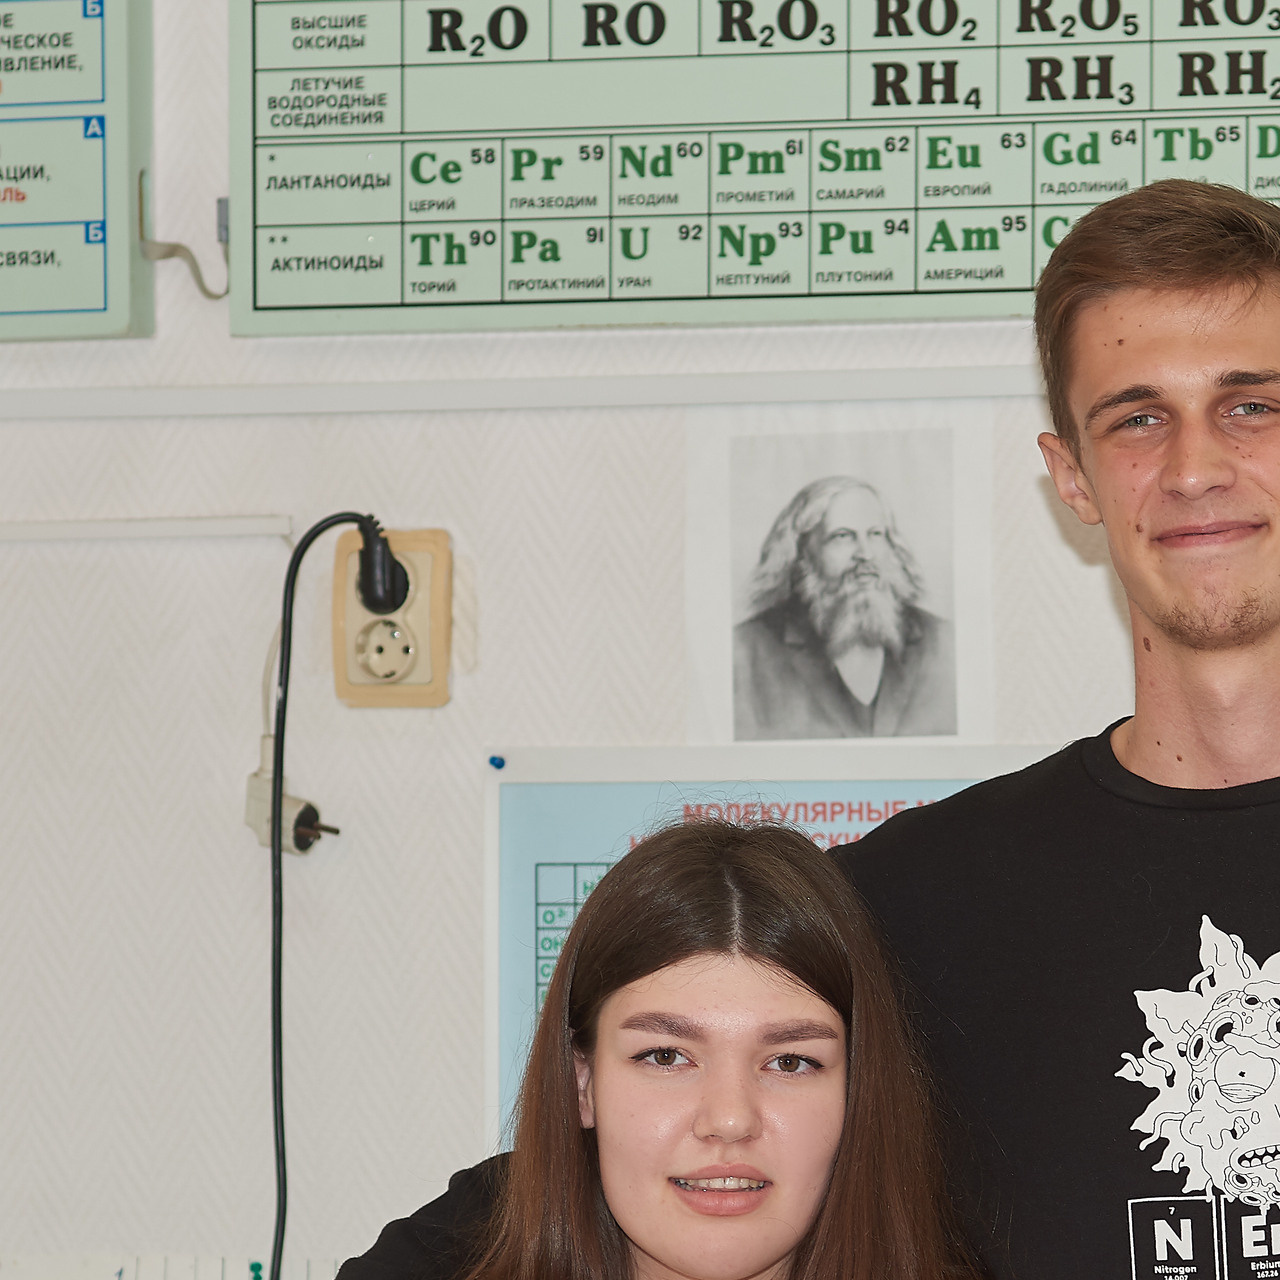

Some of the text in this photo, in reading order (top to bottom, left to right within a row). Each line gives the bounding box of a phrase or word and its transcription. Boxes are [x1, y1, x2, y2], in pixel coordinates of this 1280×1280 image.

[291, 14, 367, 31] ВЫСШИЕ
[582, 2, 666, 47] RO
[292, 35, 365, 50] ОКСИДЫ
[0, 54, 83, 72] ВЛЕНИЕ,
[291, 76, 365, 93] ЛЕТУЧИЕ
[267, 93, 387, 111] ВОДОРОДНЫЕ
[270, 111, 384, 128] СОЕДИНЕНИЯ
[926, 132, 1027, 170] Eu 63
[1042, 129, 1137, 166] Gd 64
[1154, 126, 1241, 161] Tb 65
[619, 142, 703, 179] Nd 60
[718, 139, 804, 175] Pm 61
[818, 136, 910, 172] Sm 62
[410, 148, 496, 184] Ce 58
[511, 145, 605, 182] Pr 59
[0, 164, 50, 182] ЦИИ,
[266, 173, 391, 191] ЛАНТАНОИДЫ
[923, 182, 992, 198] ЕВРОПИЙ
[1041, 178, 1128, 194] ГАДОЛИНИЙ
[617, 192, 679, 207] НЕОДИМ
[716, 189, 795, 203] ПРОМЕТИЙ
[816, 185, 885, 201] САМАРИЙ
[408, 198, 456, 213] ЦЕРИЙ
[509, 195, 597, 209] ПРАЗЕОДИМ
[619, 224, 703, 260] U 92
[818, 219, 909, 254] Pu 94
[926, 216, 1027, 252] Am 95
[410, 230, 496, 266] Th 90
[511, 227, 604, 264] Pa 91
[718, 222, 804, 266] Np 93
[0, 250, 61, 268] ВЯЗИ,
[271, 255, 384, 272] АКТИНОИДЫ
[716, 272, 790, 286] НЕПТУНИЙ
[815, 269, 893, 284] ПЛУТОНИЙ
[924, 265, 1004, 281] АМЕРИЦИЙ
[410, 280, 456, 294] ТОРИЙ
[508, 276, 605, 292] ПРОТАКТИНИЙ
[617, 276, 651, 289] УРАН
[1169, 1207, 1175, 1215] 7
[1154, 1264, 1197, 1275] Nitrogen
